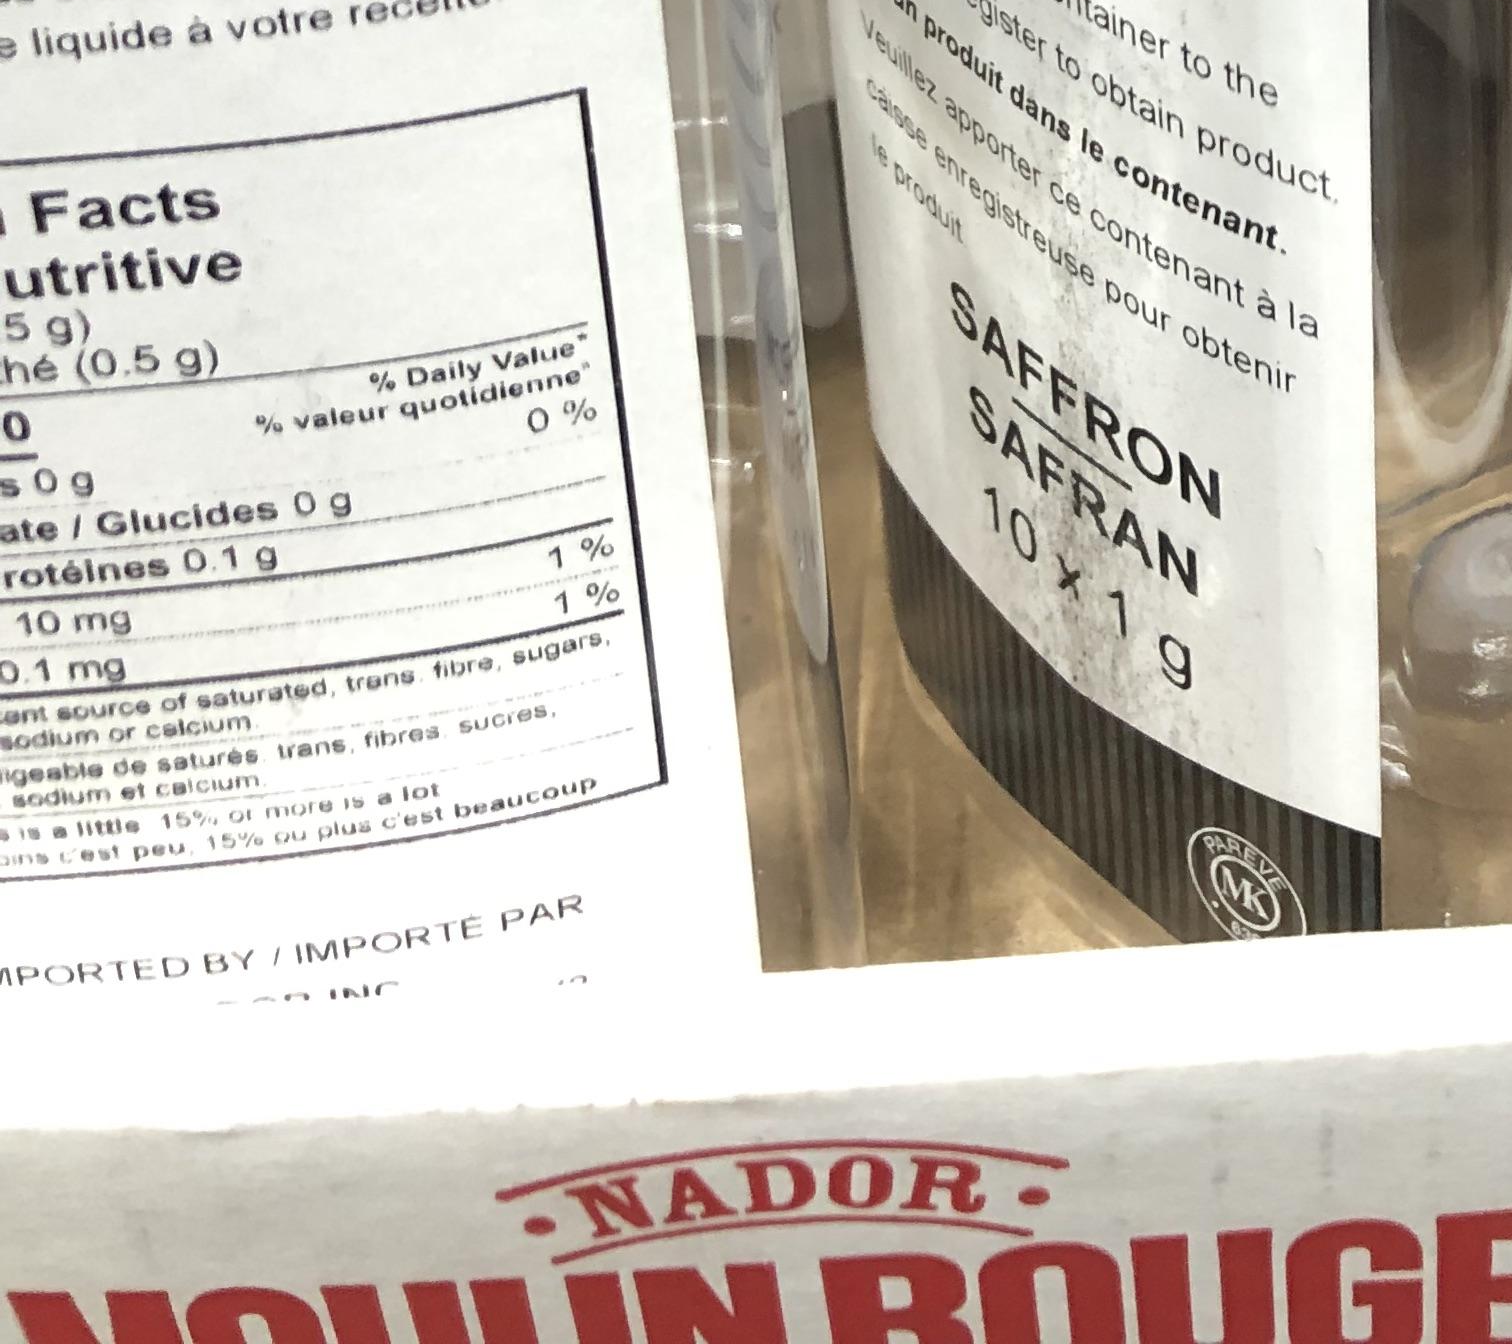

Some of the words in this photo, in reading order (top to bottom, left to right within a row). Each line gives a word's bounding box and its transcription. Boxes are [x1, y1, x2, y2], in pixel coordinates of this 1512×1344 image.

[32, 20, 172, 61] liquide
[188, 16, 212, 46] à
[227, 1, 332, 41] votre
[1180, 42, 1211, 79] to
[1224, 62, 1278, 106] the
[924, 12, 1003, 96] produit
[1010, 84, 1070, 142] dans
[1081, 128, 1103, 162] le
[1114, 155, 1288, 256] contenant.
[1055, 43, 1081, 80] to
[1092, 73, 1184, 138] obtain
[1198, 126, 1340, 200] product.
[860, 10, 939, 106] Veuillez
[945, 97, 1041, 187] apporter
[1050, 182, 1080, 216] ce
[1090, 210, 1246, 309] contenant
[1257, 289, 1276, 321] à
[1289, 301, 1318, 339] la
[872, 134, 887, 167] le
[893, 155, 968, 244] produit
[30, 183, 220, 234] Facts
[867, 79, 927, 155] caisse
[935, 144, 1096, 288] enregistreuse
[1106, 279, 1171, 332] pour
[1183, 325, 1296, 392] obtenir
[5, 248, 242, 300] utritive
[46, 309, 90, 347] g)
[75, 345, 160, 385] (0.5
[175, 338, 219, 377] g)
[369, 371, 396, 393] %
[407, 360, 481, 387] Daily
[256, 415, 283, 434] %
[294, 405, 388, 430] valeur
[527, 407, 549, 434] 0
[563, 398, 597, 425] %
[951, 279, 1221, 521] SAFFRON
[33, 468, 57, 495] 0
[71, 471, 94, 499] g
[970, 384, 1198, 601] SAFRAN
[97, 494, 278, 541] Glucides
[294, 491, 316, 518] 0
[330, 492, 352, 520] g
[183, 545, 237, 574] 0.1
[256, 546, 277, 572] g
[549, 546, 562, 568] 1
[581, 534, 614, 561] %
[555, 591, 568, 614] 1
[586, 582, 619, 606] %
[984, 487, 1037, 563] 10
[1056, 553, 1081, 603] x
[1107, 590, 1127, 640] 1
[1159, 634, 1192, 690] g
[16, 610, 60, 637] 10
[73, 610, 131, 637] mg
[57, 700, 150, 721] source
[196, 678, 335, 710] saturated,
[433, 658, 502, 678] fibre,
[513, 633, 609, 665] sugars,
[69, 657, 127, 683] mg
[459, 705, 555, 734] sucres,
[13, 789, 111, 808] sodium
[266, 800, 333, 819] more
[403, 783, 439, 801] lot
[318, 821, 371, 842] plus
[454, 778, 596, 818] beaucoup
[1203, 835, 1287, 892] PAREVE
[1221, 864, 1270, 921] MK
[204, 950, 253, 974] BY
[296, 914, 483, 964] IMPORTÉ
[501, 895, 583, 931] PAR
[566, 1154, 987, 1239] NADOR
